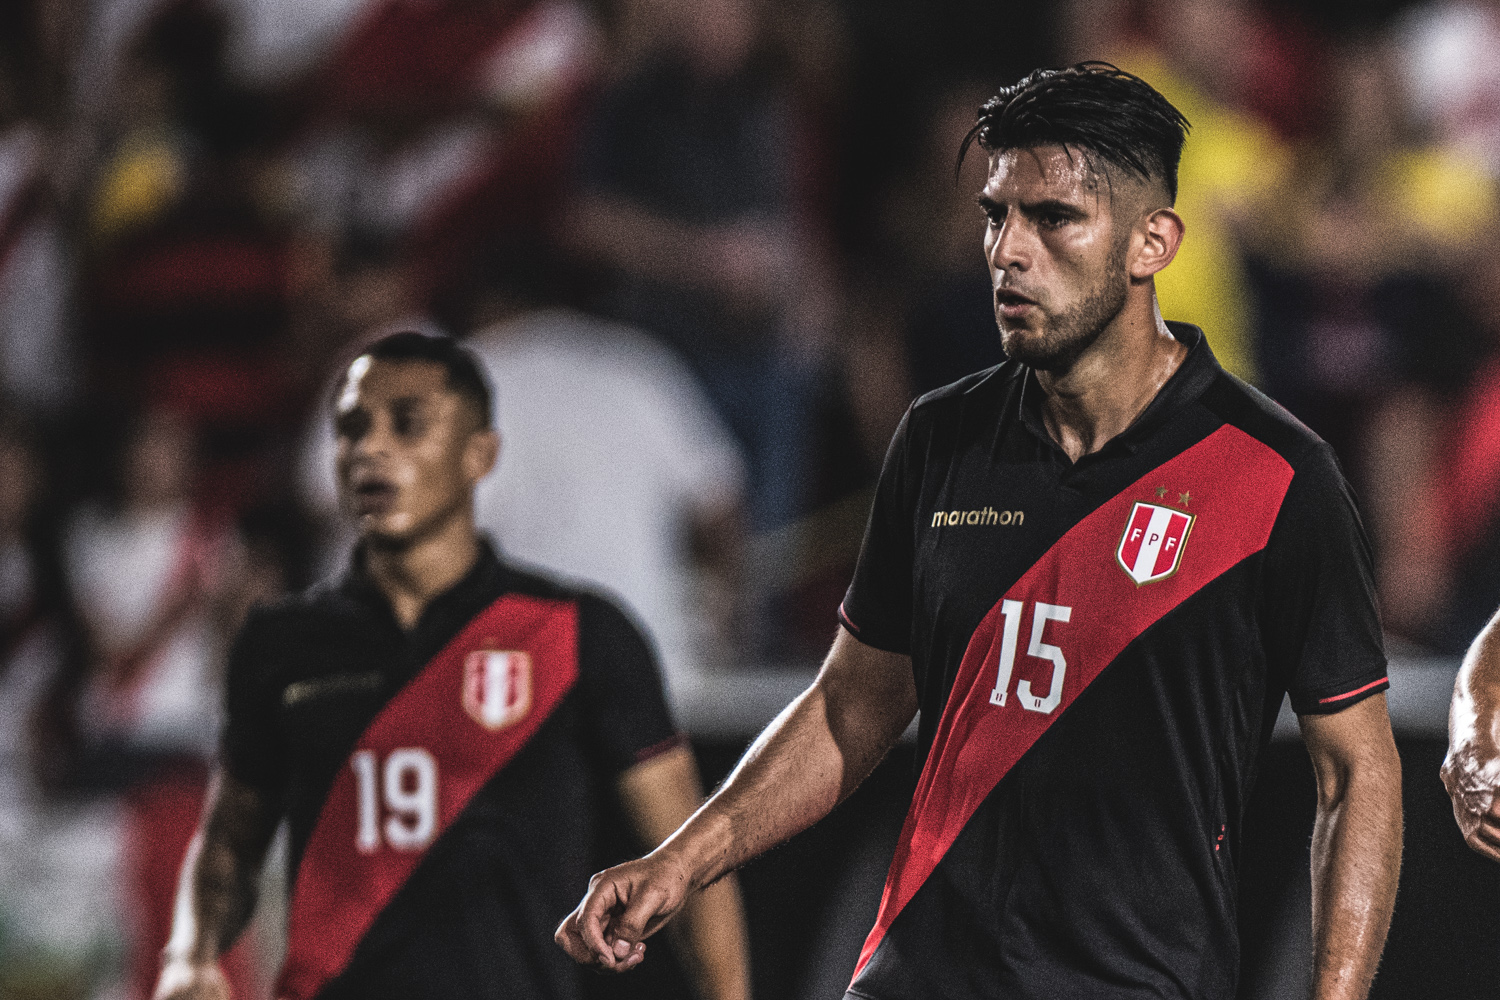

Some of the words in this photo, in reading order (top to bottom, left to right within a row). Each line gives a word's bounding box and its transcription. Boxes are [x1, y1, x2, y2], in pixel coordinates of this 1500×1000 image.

[931, 506, 1025, 528] marathon
[989, 599, 1072, 714] 15
[350, 748, 440, 854] 19
